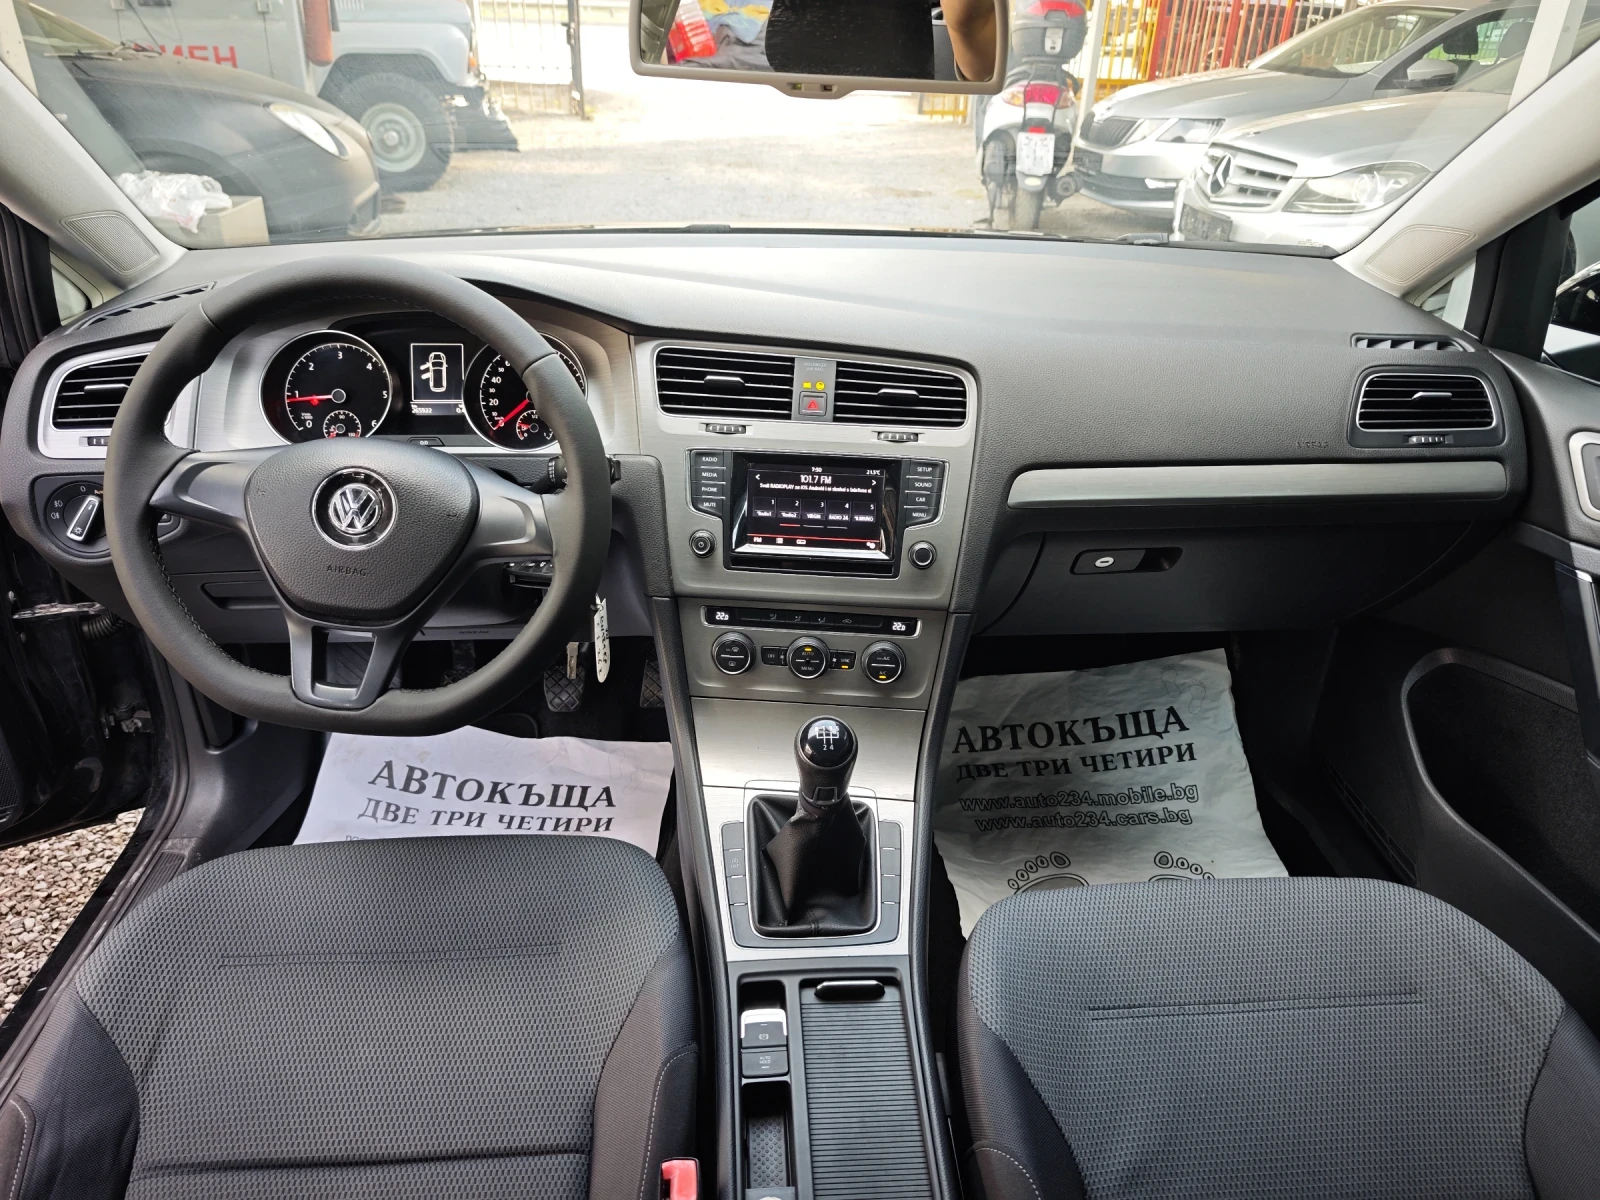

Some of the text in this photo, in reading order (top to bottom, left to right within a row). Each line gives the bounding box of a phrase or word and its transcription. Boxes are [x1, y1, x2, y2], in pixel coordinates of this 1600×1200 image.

[337, 351, 343, 360] 3
[308, 362, 315, 371] 2
[366, 362, 373, 371] 4
[491, 376, 502, 384] 40
[382, 390, 388, 399] 5
[489, 398, 499, 406] 20
[306, 420, 313, 429] 0
[371, 419, 378, 428] 6
[800, 474, 832, 485] 101.7 FM
[326, 564, 367, 577] AIRBAG
[952, 705, 1190, 754] АВТОКЪЩА
[956, 742, 1197, 784] ДВЕ ТРИ ЧЕТИРИ
[367, 759, 617, 812] АВТОКЪЩА
[959, 782, 1200, 812] www.auto234.mobile.bg
[357, 797, 614, 833] ДВЕ ТРИ ЧЕТИРИ
[975, 807, 1193, 832] www.auto234.cars.bg
